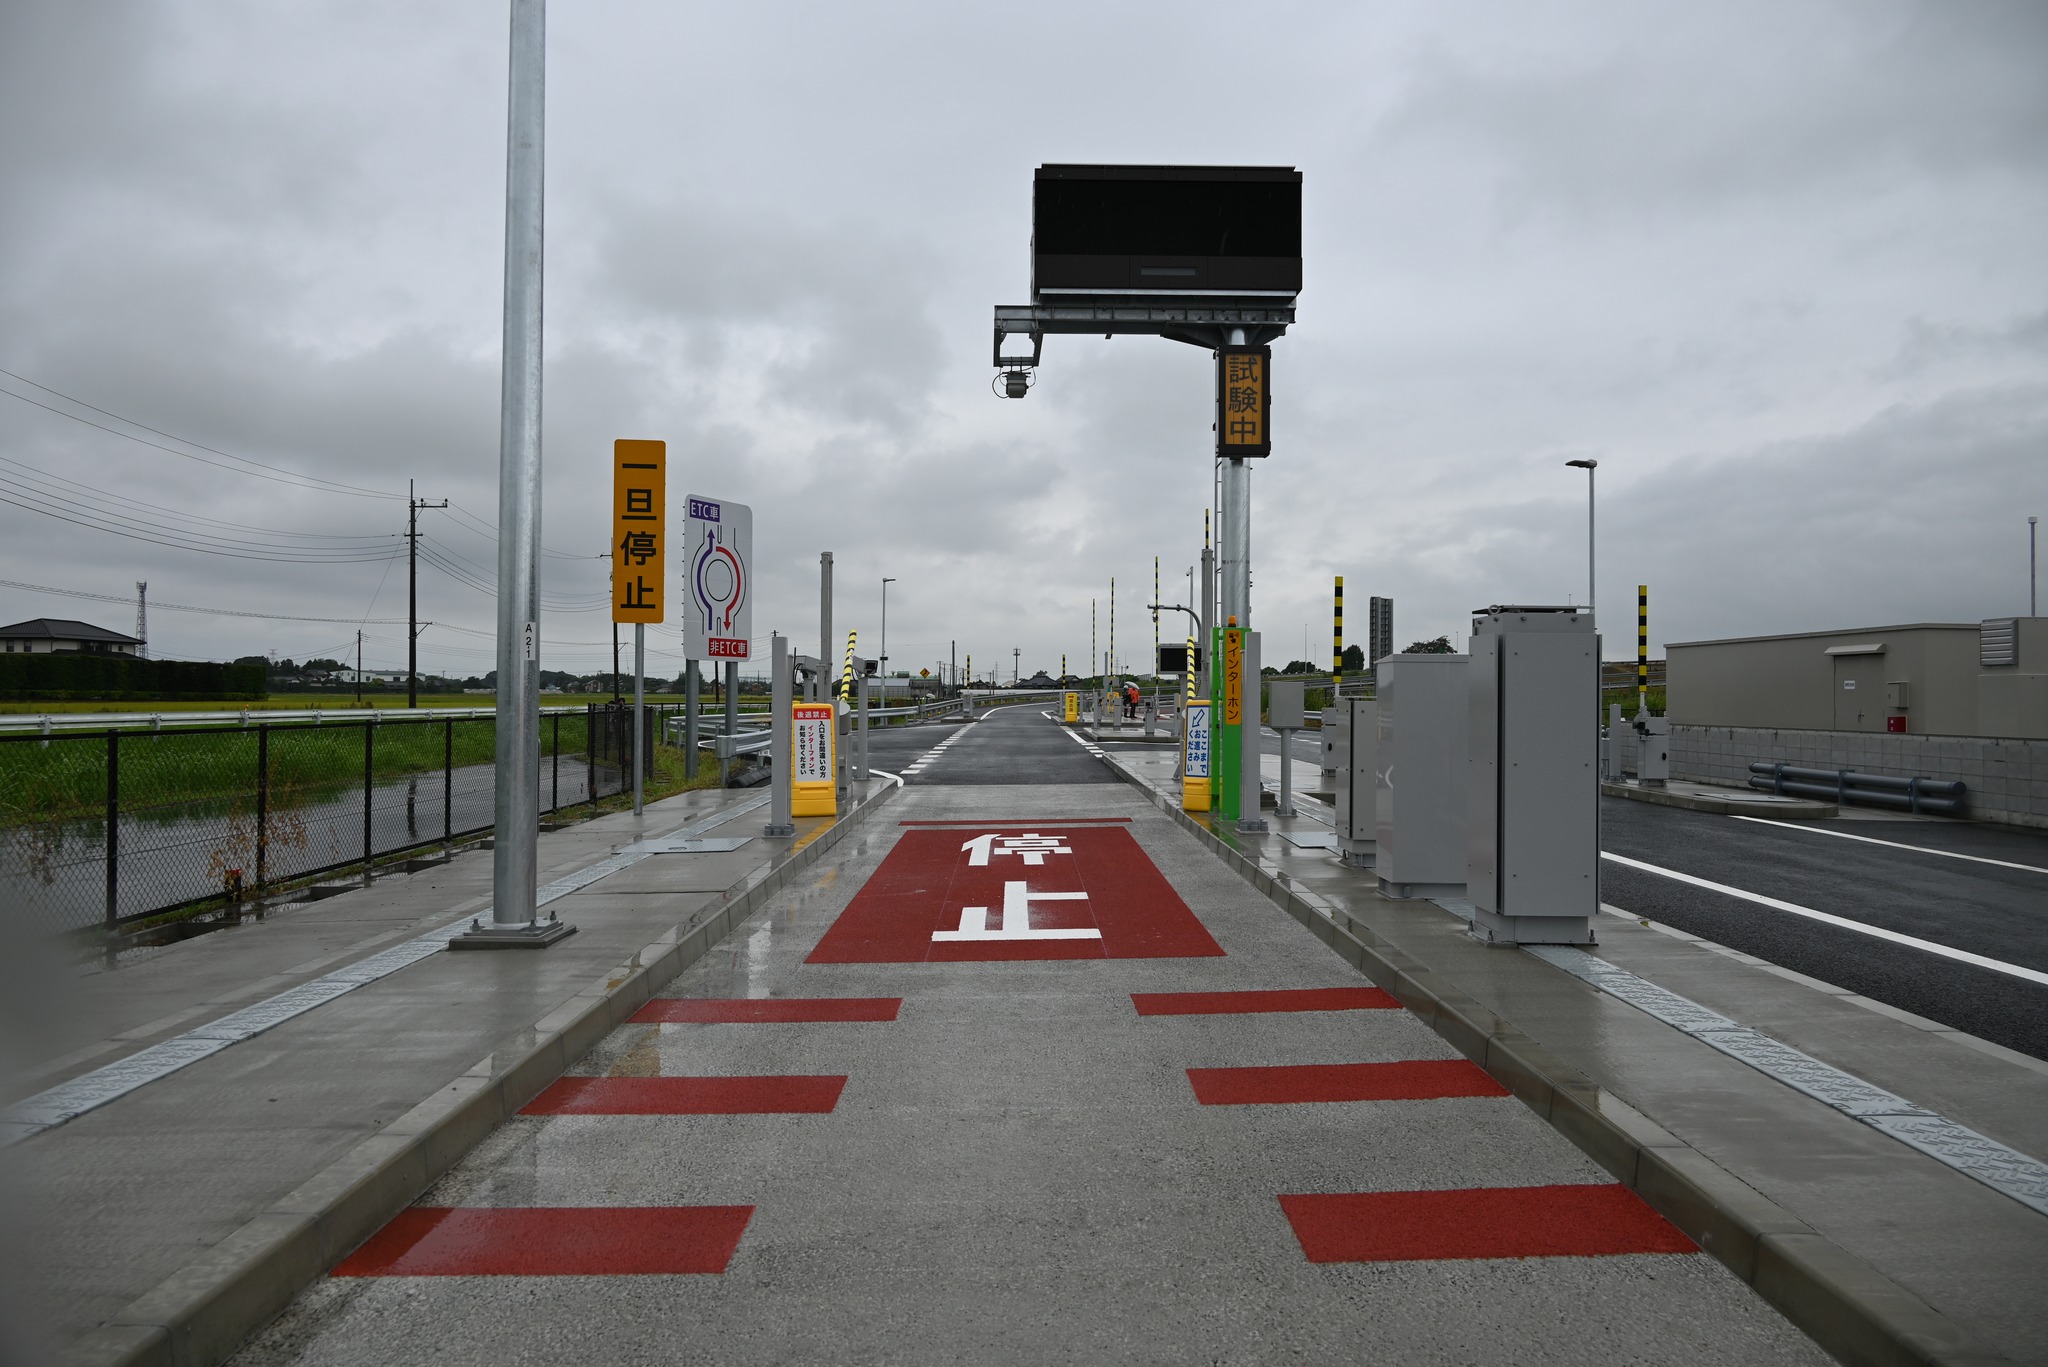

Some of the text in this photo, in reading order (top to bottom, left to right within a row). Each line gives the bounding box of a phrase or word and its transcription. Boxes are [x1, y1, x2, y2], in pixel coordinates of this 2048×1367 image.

[1229, 357, 1258, 443] 試験中
[691, 502, 719, 519] ETC車
[620, 463, 657, 609] 一旦停止
[710, 640, 746, 655] 非ETC車
[1228, 647, 1239, 720] インターホン
[799, 725, 807, 775] お知らせください
[818, 720, 826, 779] 入口をお間違いの方
[1193, 730, 1201, 762] お進み
[1200, 730, 1208, 773] ここまで
